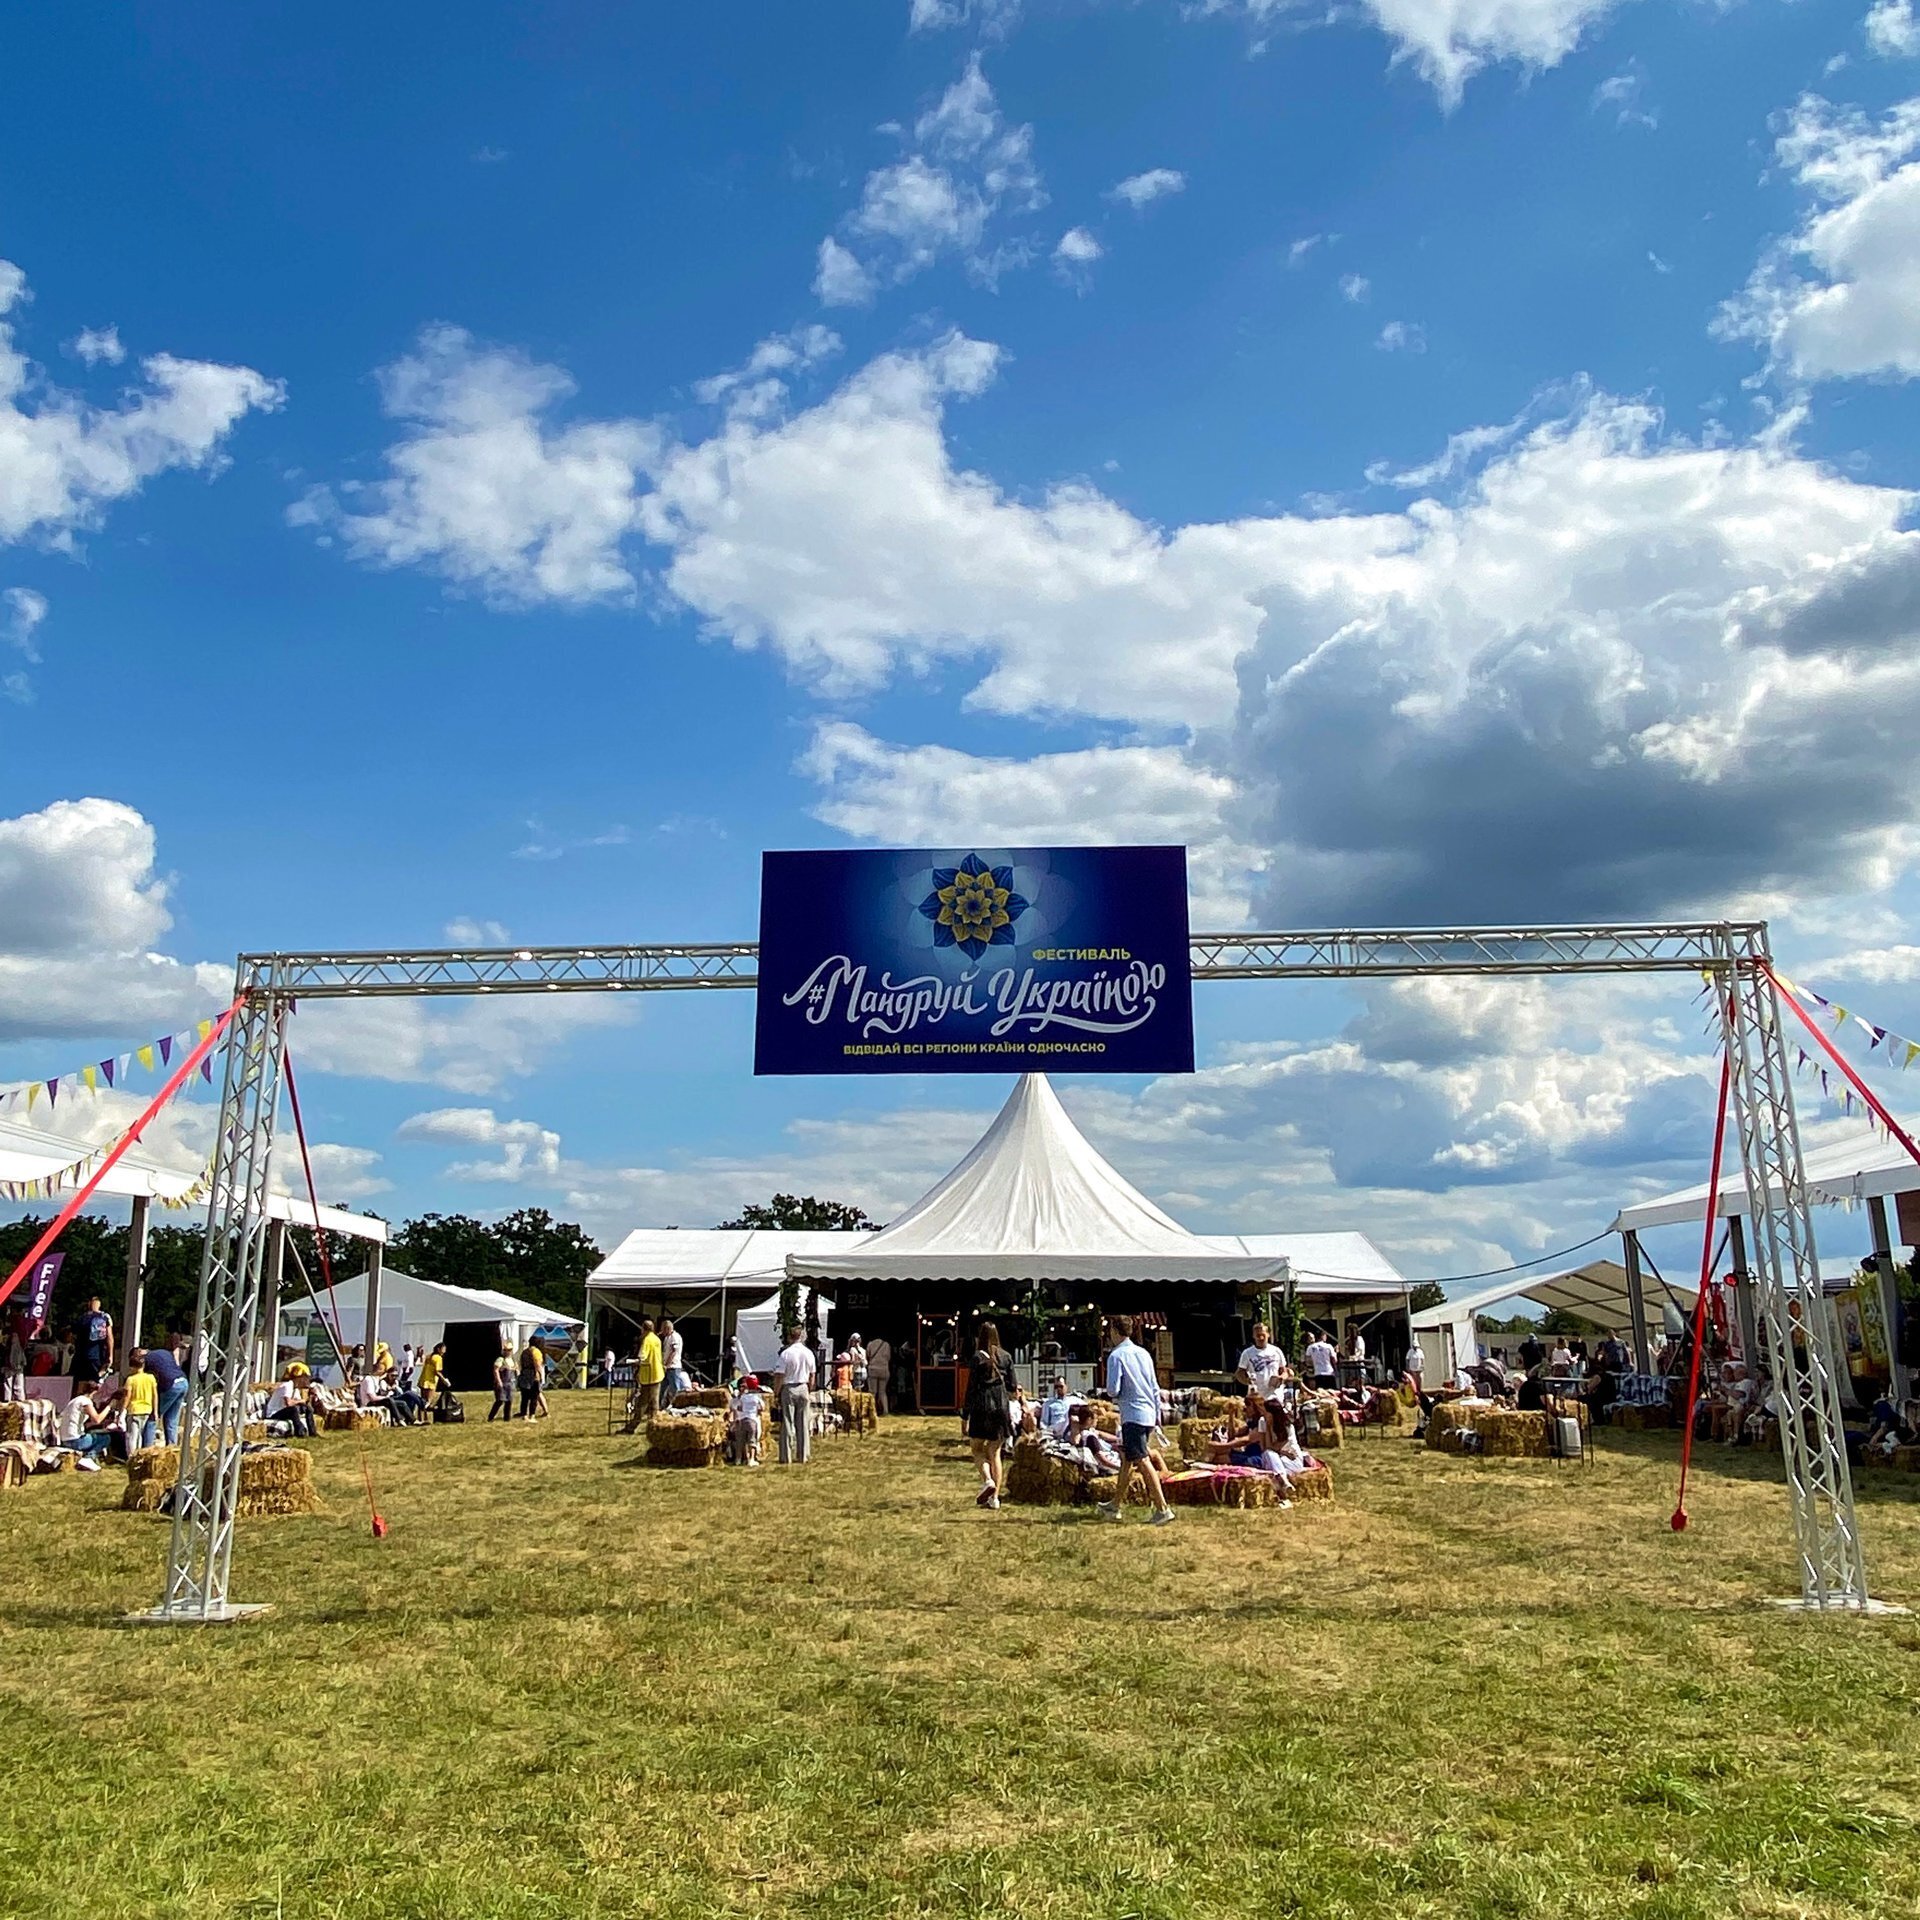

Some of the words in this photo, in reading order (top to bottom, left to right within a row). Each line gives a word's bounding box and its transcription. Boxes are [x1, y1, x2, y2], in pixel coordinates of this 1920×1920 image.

[1032, 948, 1131, 961] ФЕСТИВАЛЬ
[783, 955, 988, 1039] #Мандруй
[988, 960, 1166, 1037] Україною
[843, 1042, 901, 1055] ВІДВІДАЙ
[903, 1043, 923, 1055] ВСІ
[925, 1043, 977, 1055] РЕГІОНИ
[980, 1041, 1025, 1054] КРАЇНИ
[1028, 1043, 1106, 1054] ОДНОЧАСНО
[32, 1263, 55, 1318] Free
